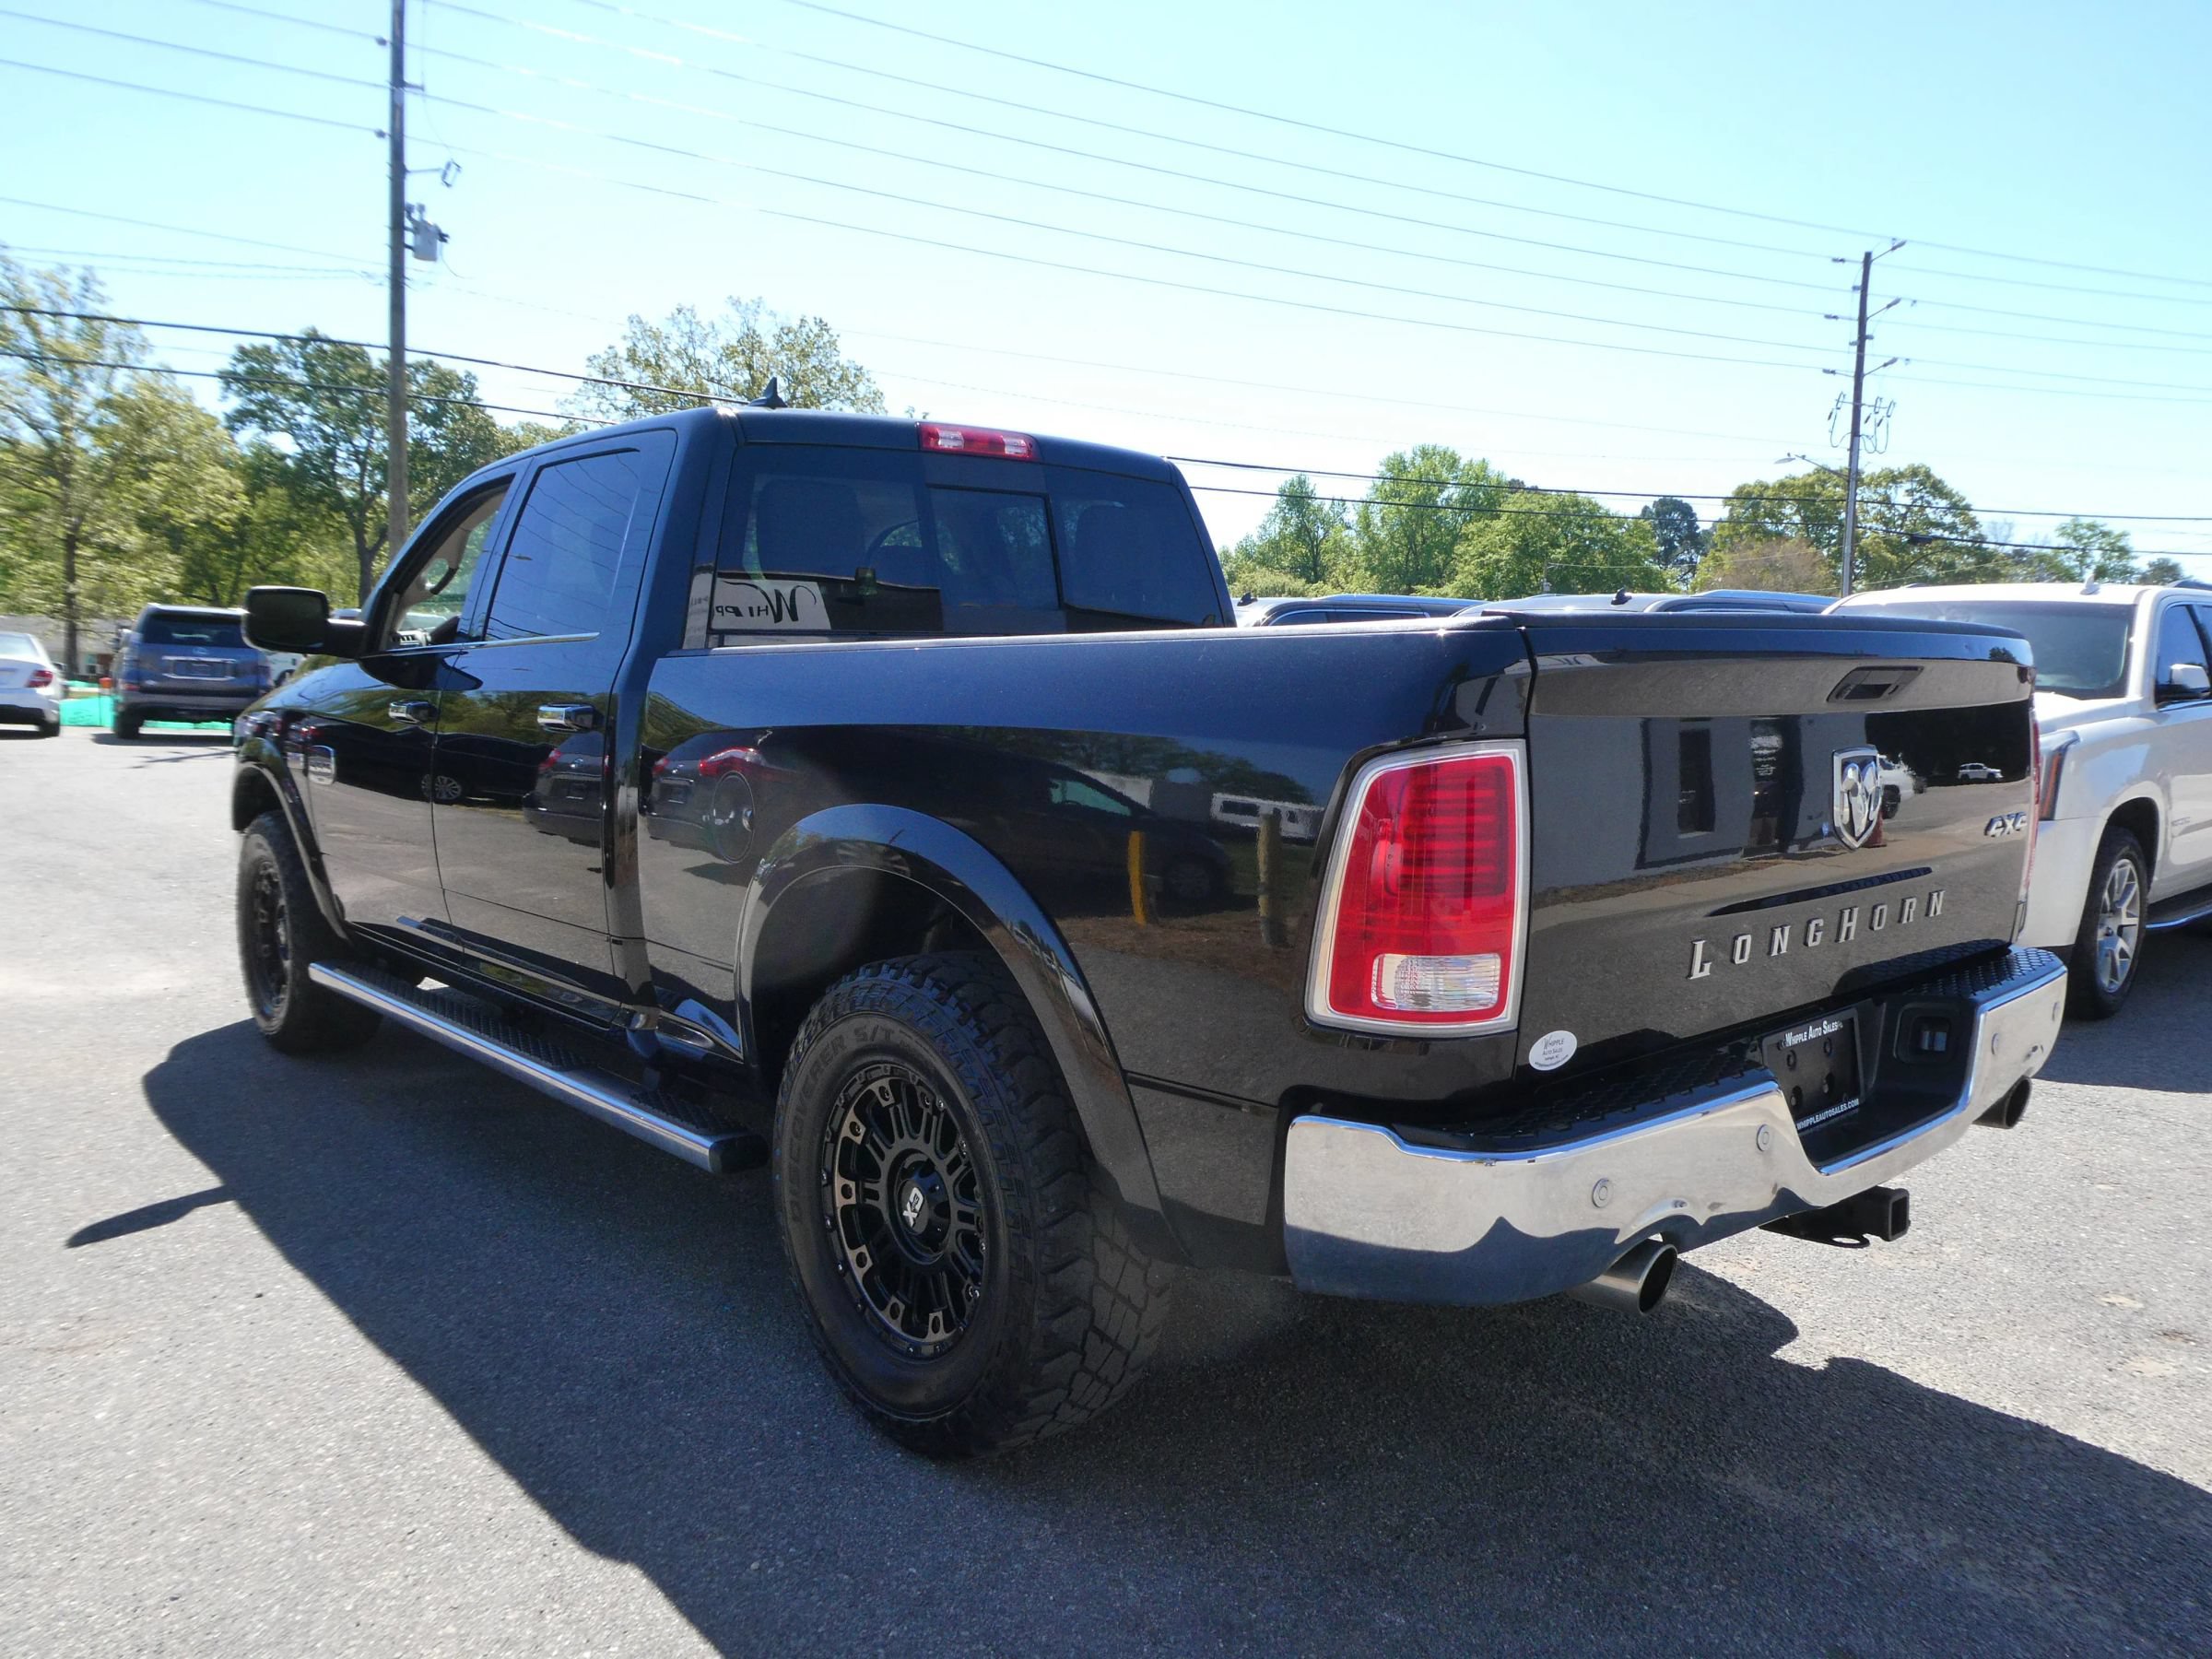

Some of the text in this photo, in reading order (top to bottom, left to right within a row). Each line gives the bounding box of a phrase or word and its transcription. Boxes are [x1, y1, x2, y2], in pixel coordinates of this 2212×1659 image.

[1687, 889, 1946, 980] LONGHORN
[1785, 1020, 1838, 1046] WHIPPLE AUTO SALES
